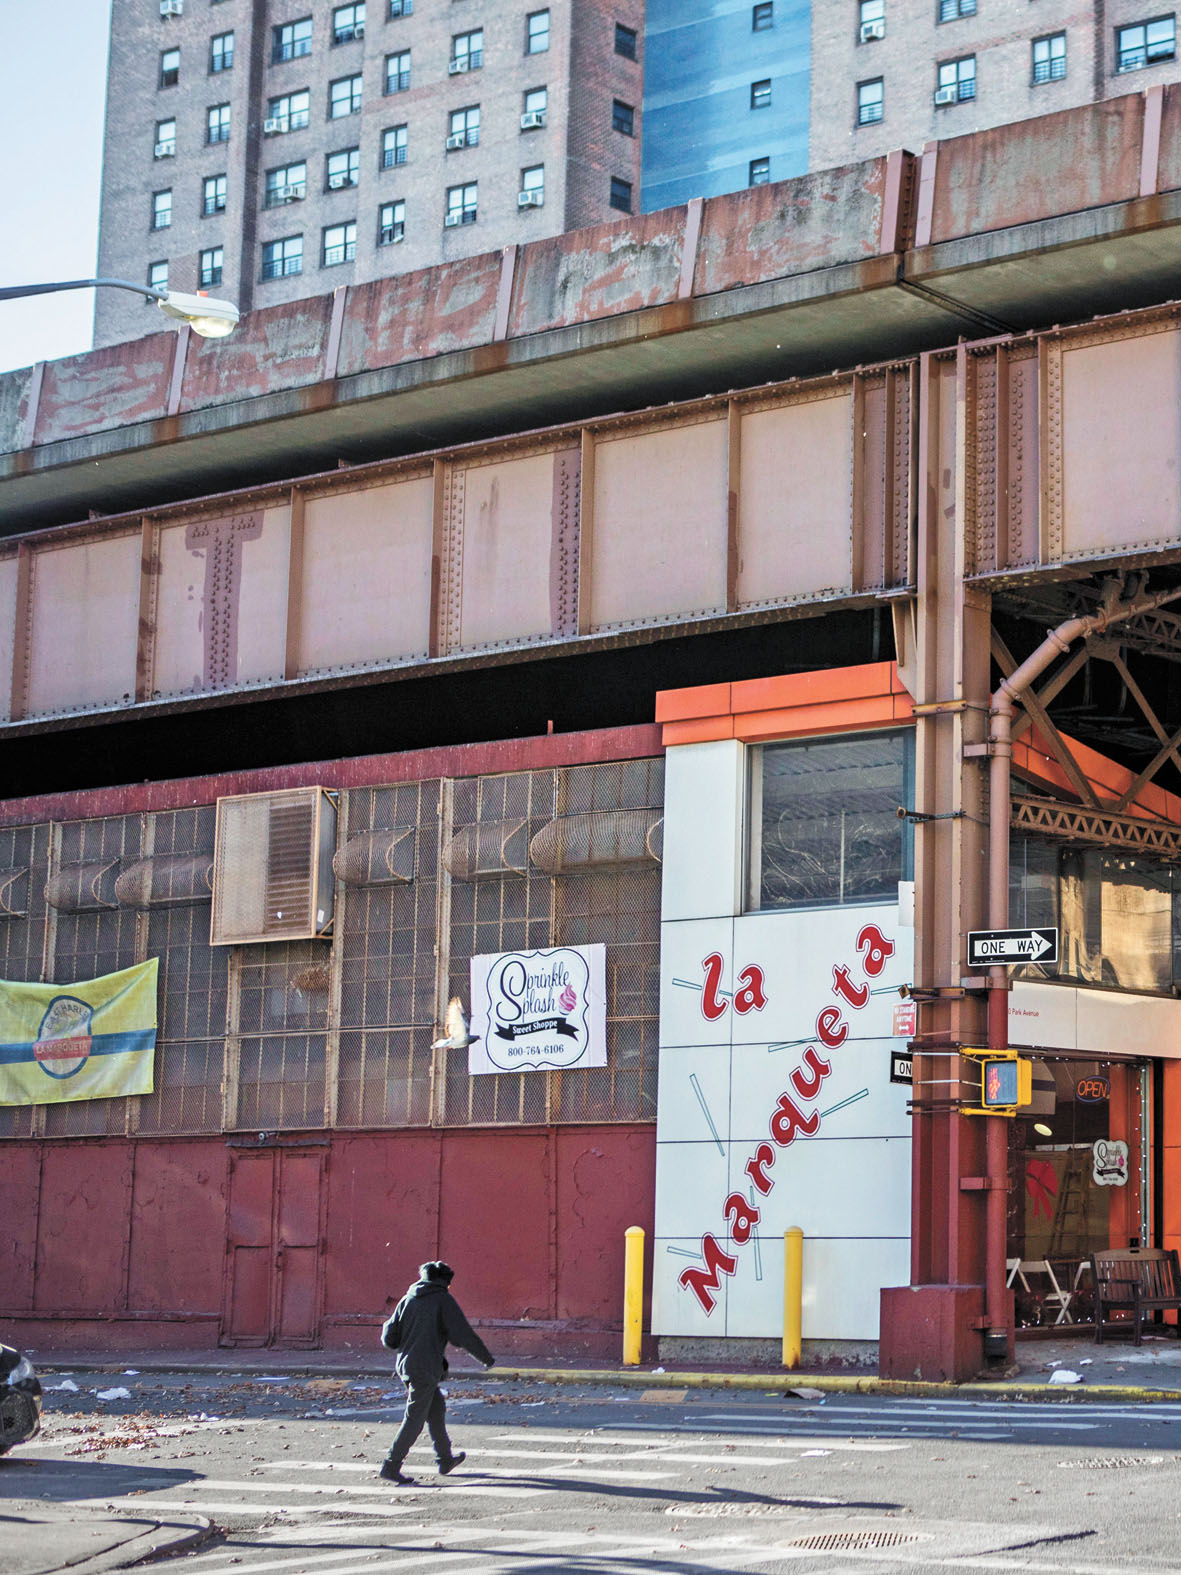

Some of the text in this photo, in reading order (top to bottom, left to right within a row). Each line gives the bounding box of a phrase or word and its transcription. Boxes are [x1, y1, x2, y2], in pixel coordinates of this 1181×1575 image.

[981, 940, 1043, 954] ONE WAY
[496, 961, 569, 1013] Sprinkle
[701, 952, 768, 1021] la
[1012, 1008, 1021, 1016] Park
[512, 1020, 558, 1034] Sweet Shoppe
[508, 1044, 564, 1057] 800-764-6106
[1077, 1080, 1107, 1098] OPEN
[678, 924, 895, 1317] Marqueta
